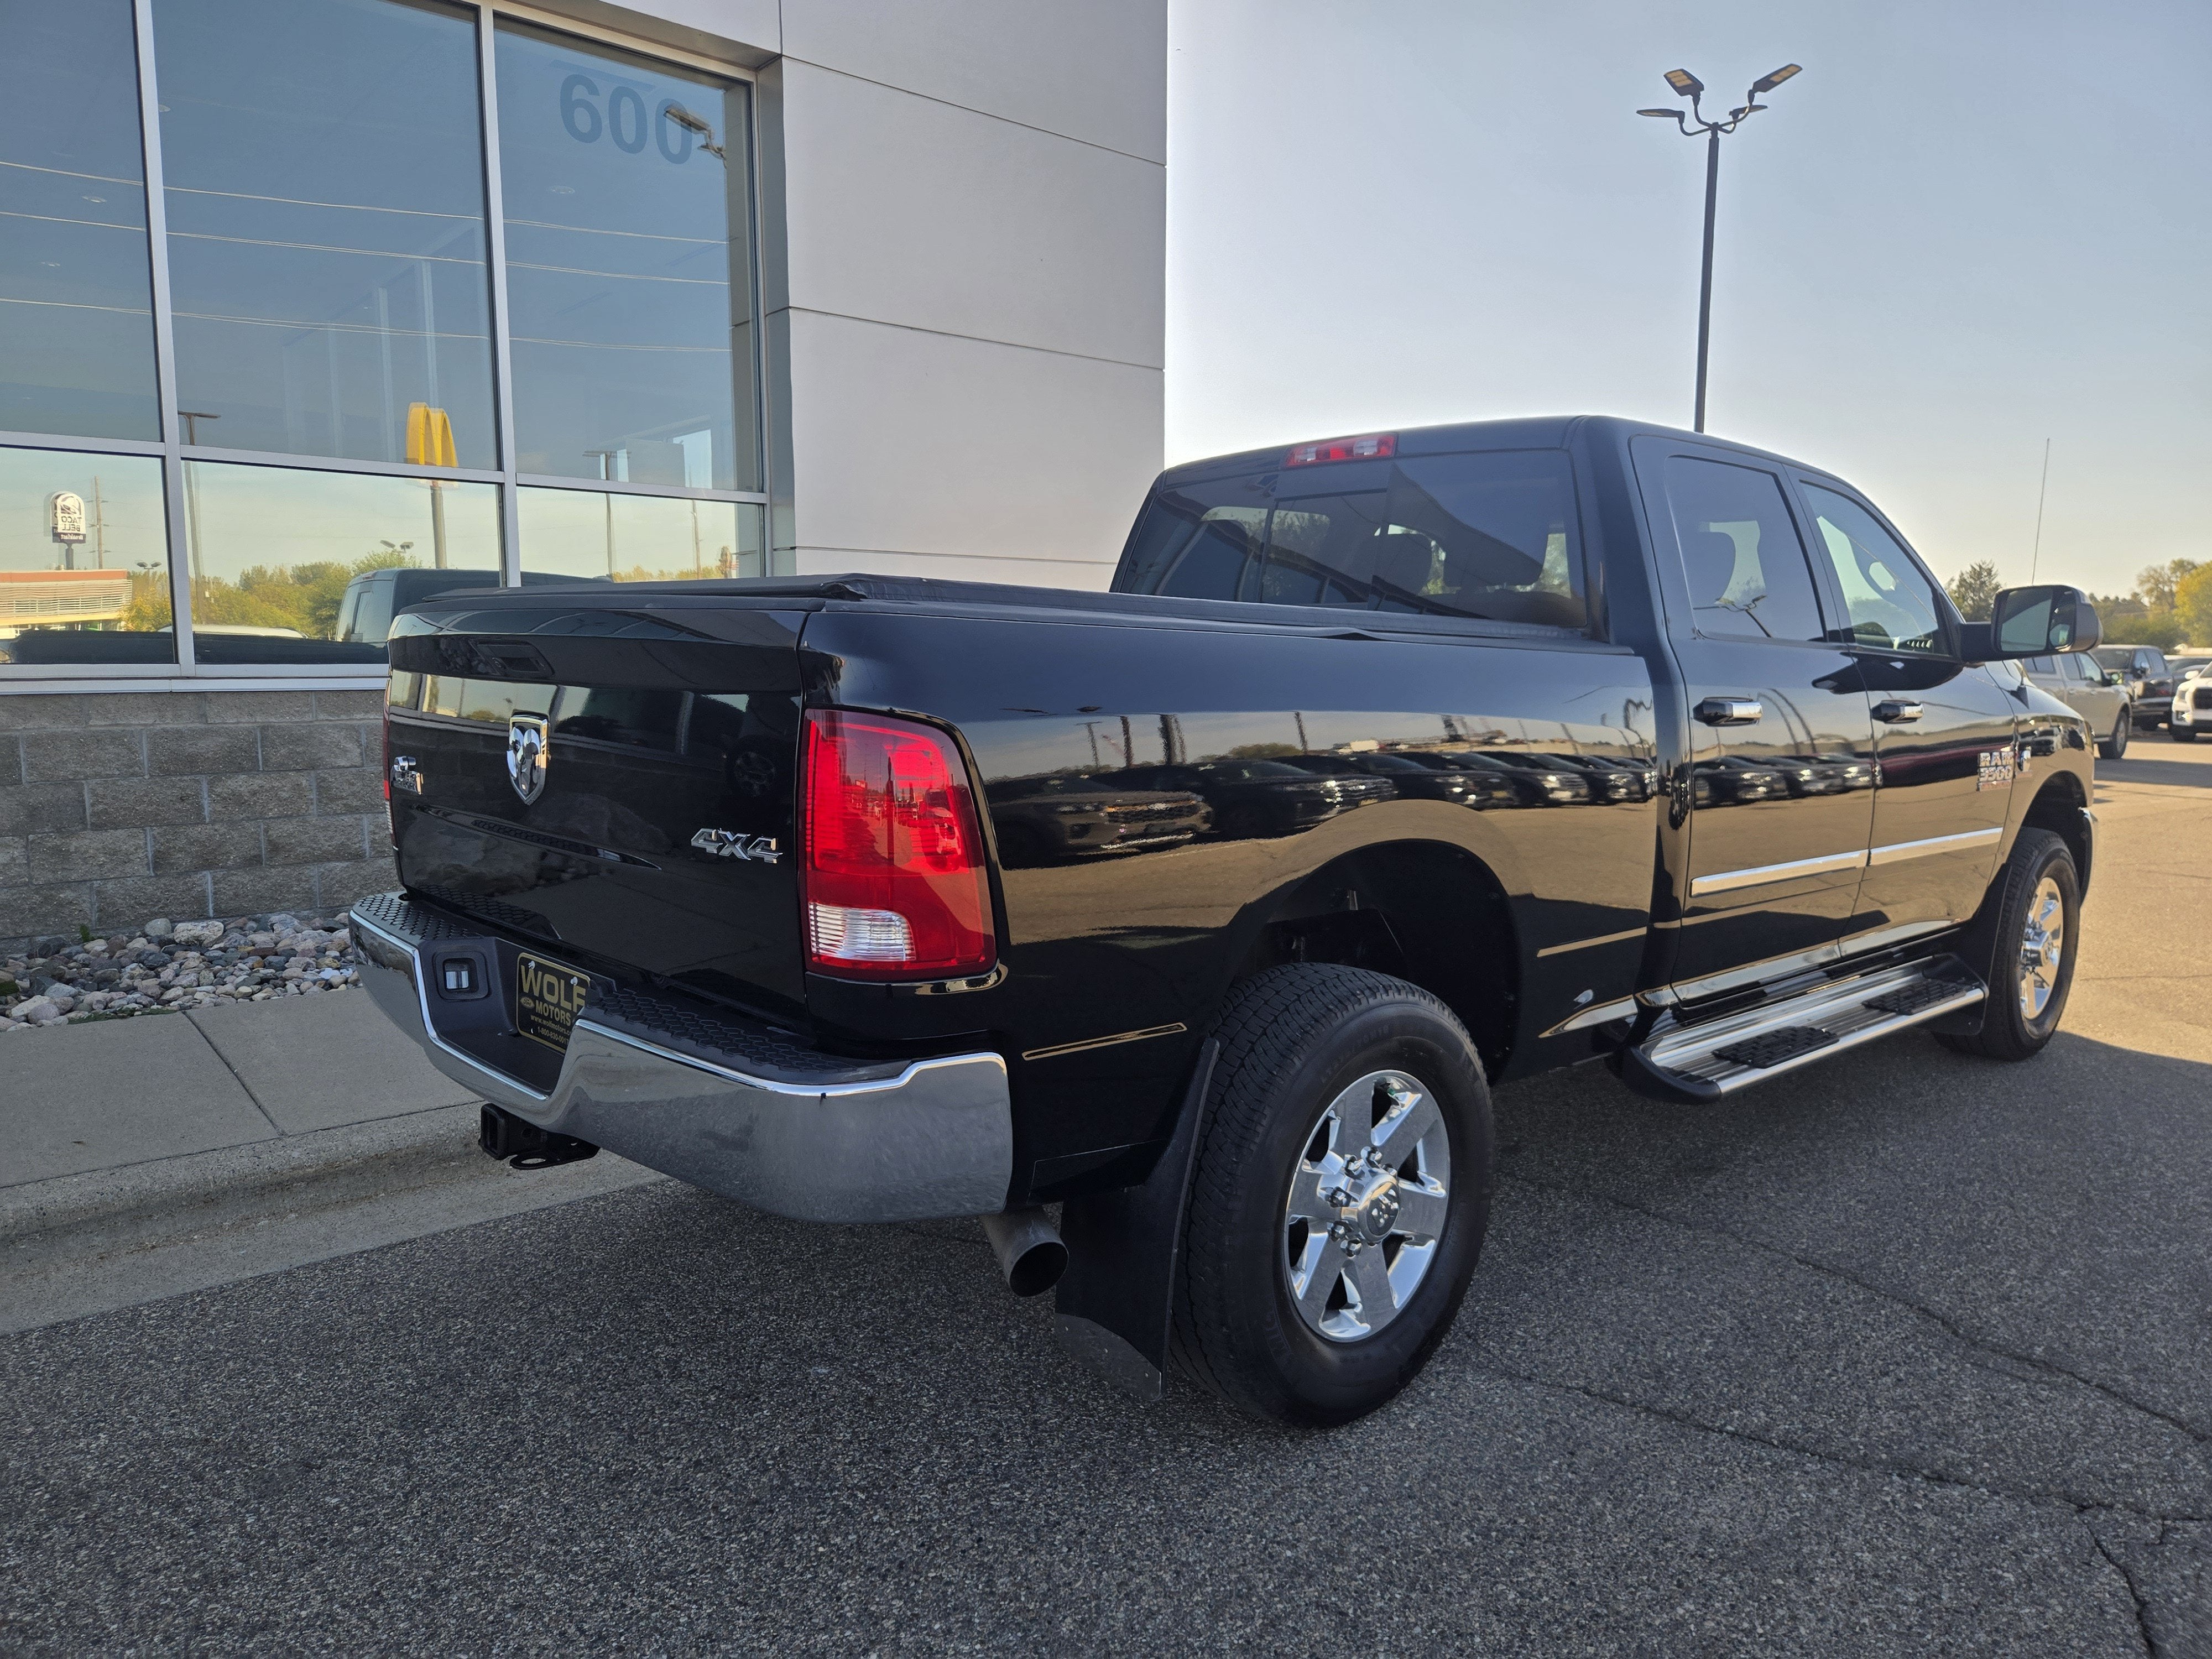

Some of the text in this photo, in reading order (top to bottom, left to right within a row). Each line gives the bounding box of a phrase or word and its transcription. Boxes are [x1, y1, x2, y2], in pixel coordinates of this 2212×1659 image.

[560, 74, 692, 164] 600
[1978, 751, 2015, 768] RAM
[520, 964, 586, 1013] WOLF
[535, 999, 571, 1026] MOTORS
